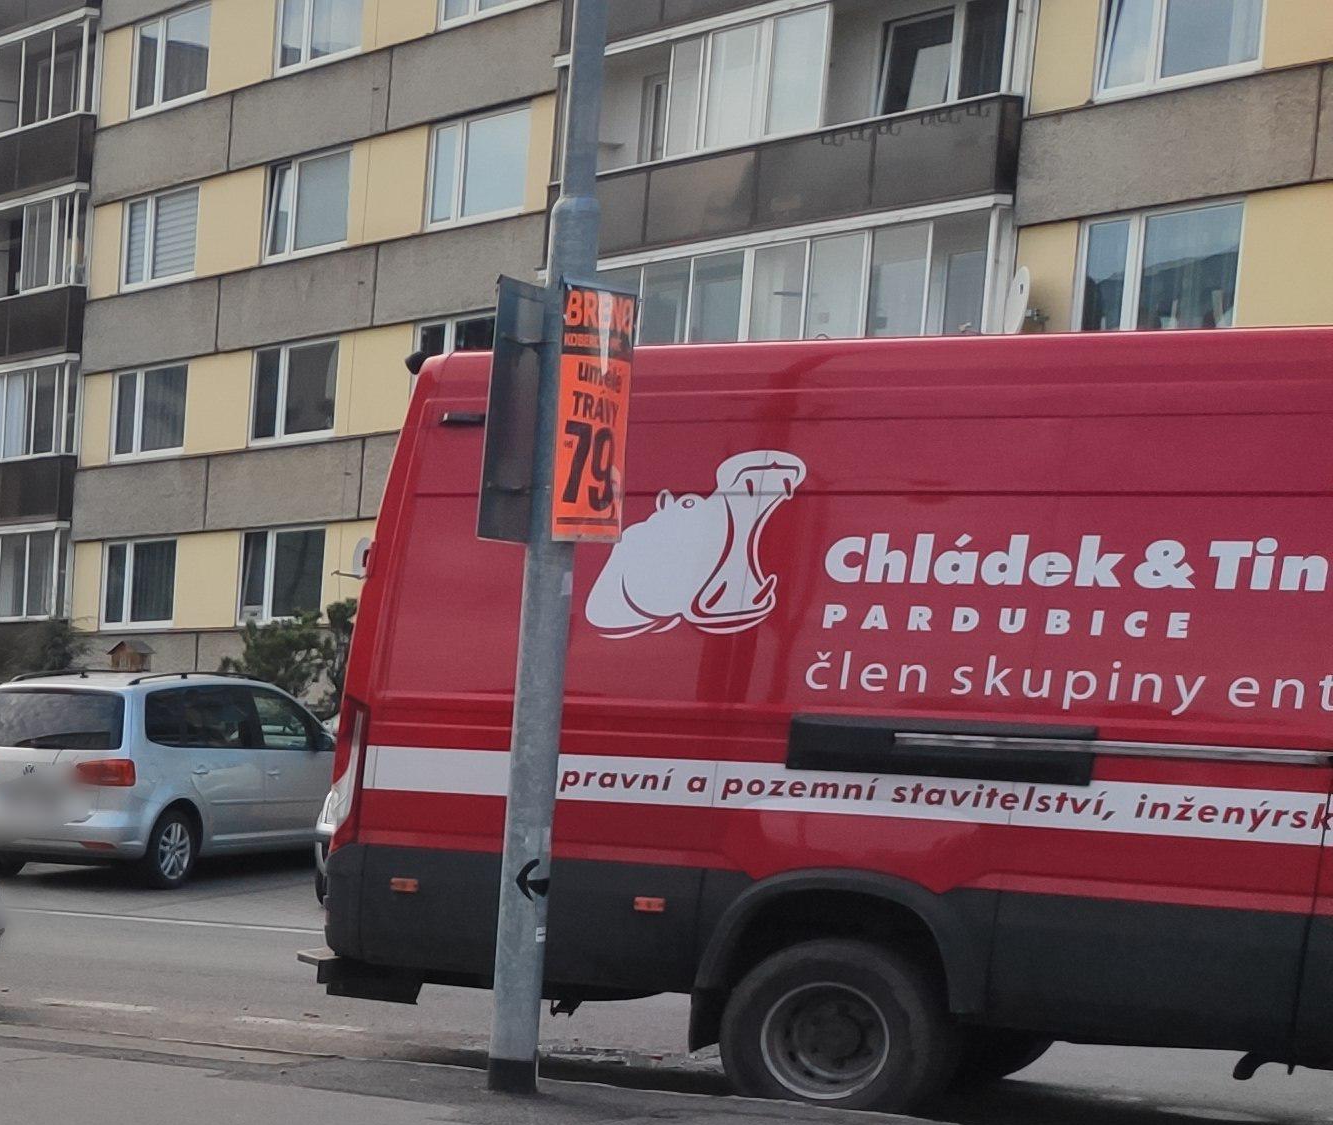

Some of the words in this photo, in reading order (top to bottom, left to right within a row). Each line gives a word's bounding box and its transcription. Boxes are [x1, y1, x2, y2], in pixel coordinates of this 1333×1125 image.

[572, 390, 619, 428] TRÁVY
[824, 532, 1126, 588] Chládek
[1133, 539, 1196, 590] &
[822, 604, 1191, 639] PARDUBICE
[805, 650, 928, 693] člen
[950, 654, 1207, 716] skupiny
[686, 776, 708, 793] a
[721, 777, 879, 801] pozemní
[891, 782, 1118, 821] stavitelství,
